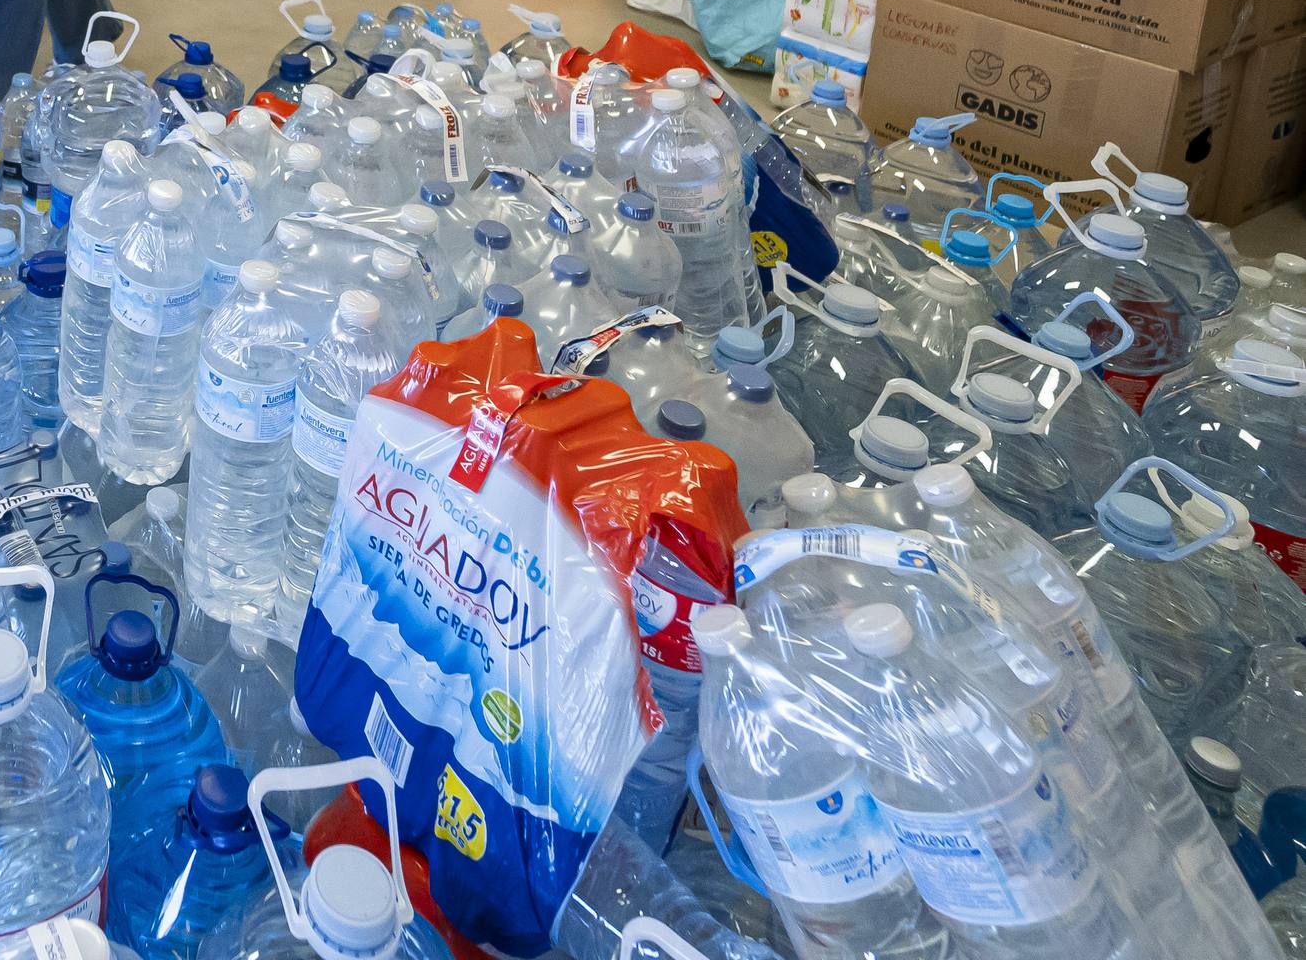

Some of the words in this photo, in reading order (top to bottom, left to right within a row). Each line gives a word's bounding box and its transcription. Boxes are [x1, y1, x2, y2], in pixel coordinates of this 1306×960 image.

[1094, 5, 1127, 20] dado
[1129, 14, 1159, 29] vida
[440, 105, 457, 139] FROIZ
[960, 91, 1039, 131] GADIS
[969, 137, 998, 158] del
[413, 579, 432, 610] DE
